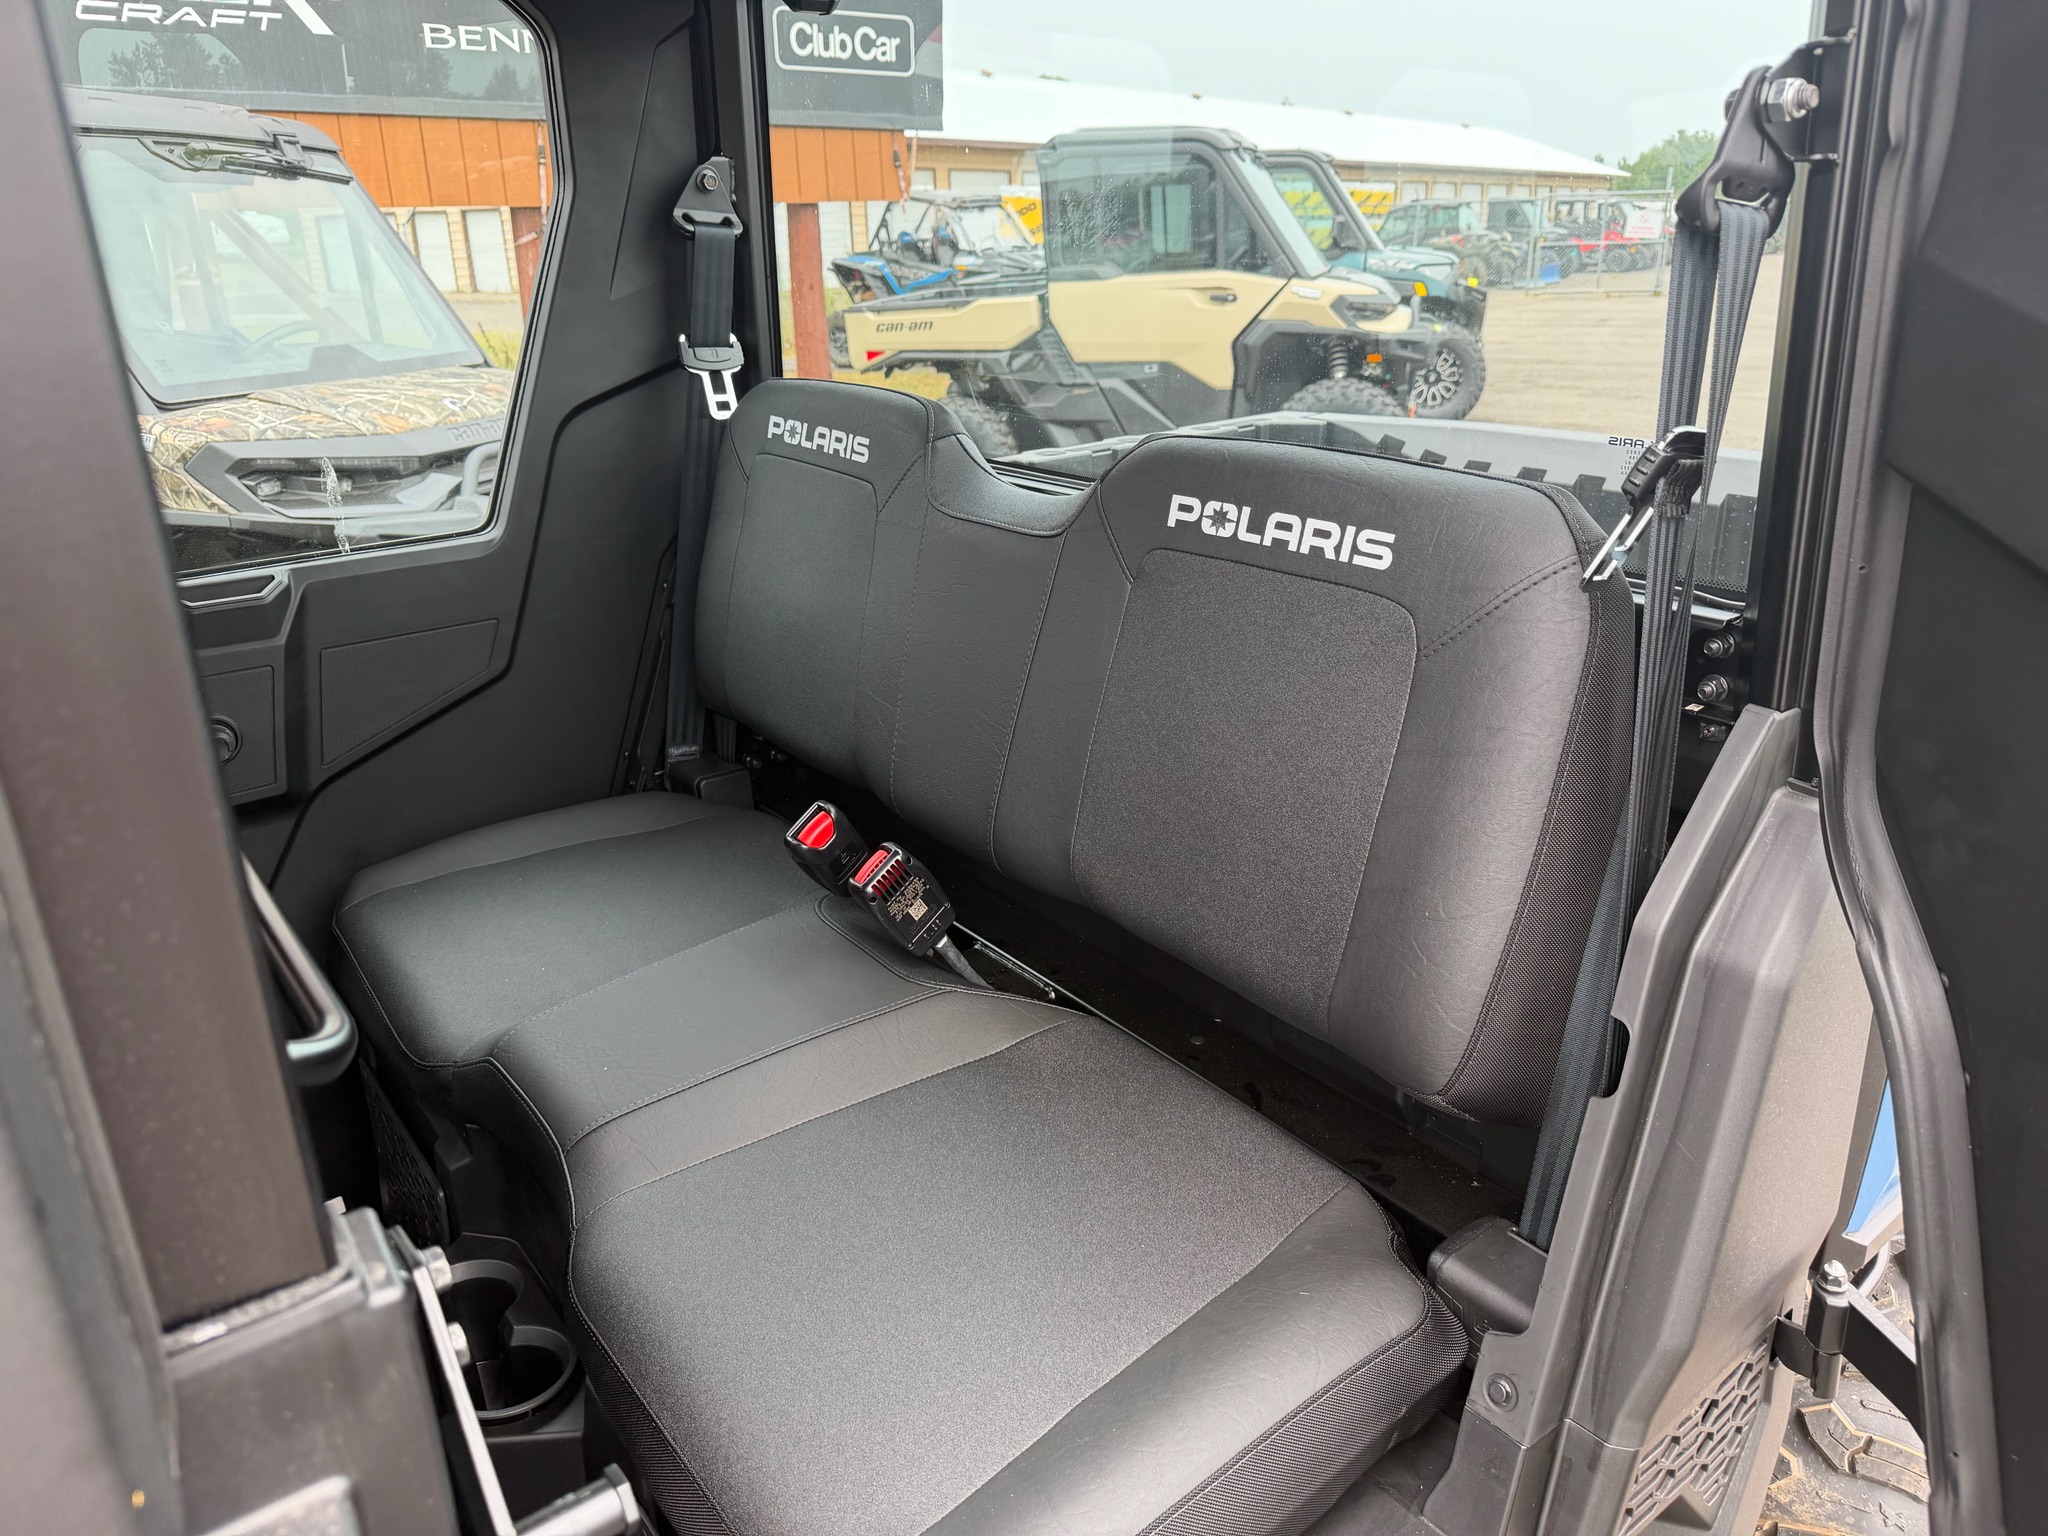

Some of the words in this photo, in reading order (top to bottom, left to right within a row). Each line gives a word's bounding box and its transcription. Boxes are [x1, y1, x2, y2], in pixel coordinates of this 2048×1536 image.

[75, 0, 283, 31] CRAFT
[789, 21, 853, 60] Club
[853, 26, 901, 62] Car
[876, 320, 934, 333] can-am
[767, 414, 870, 464] POLARIS
[1167, 494, 1396, 570] POLARIS
